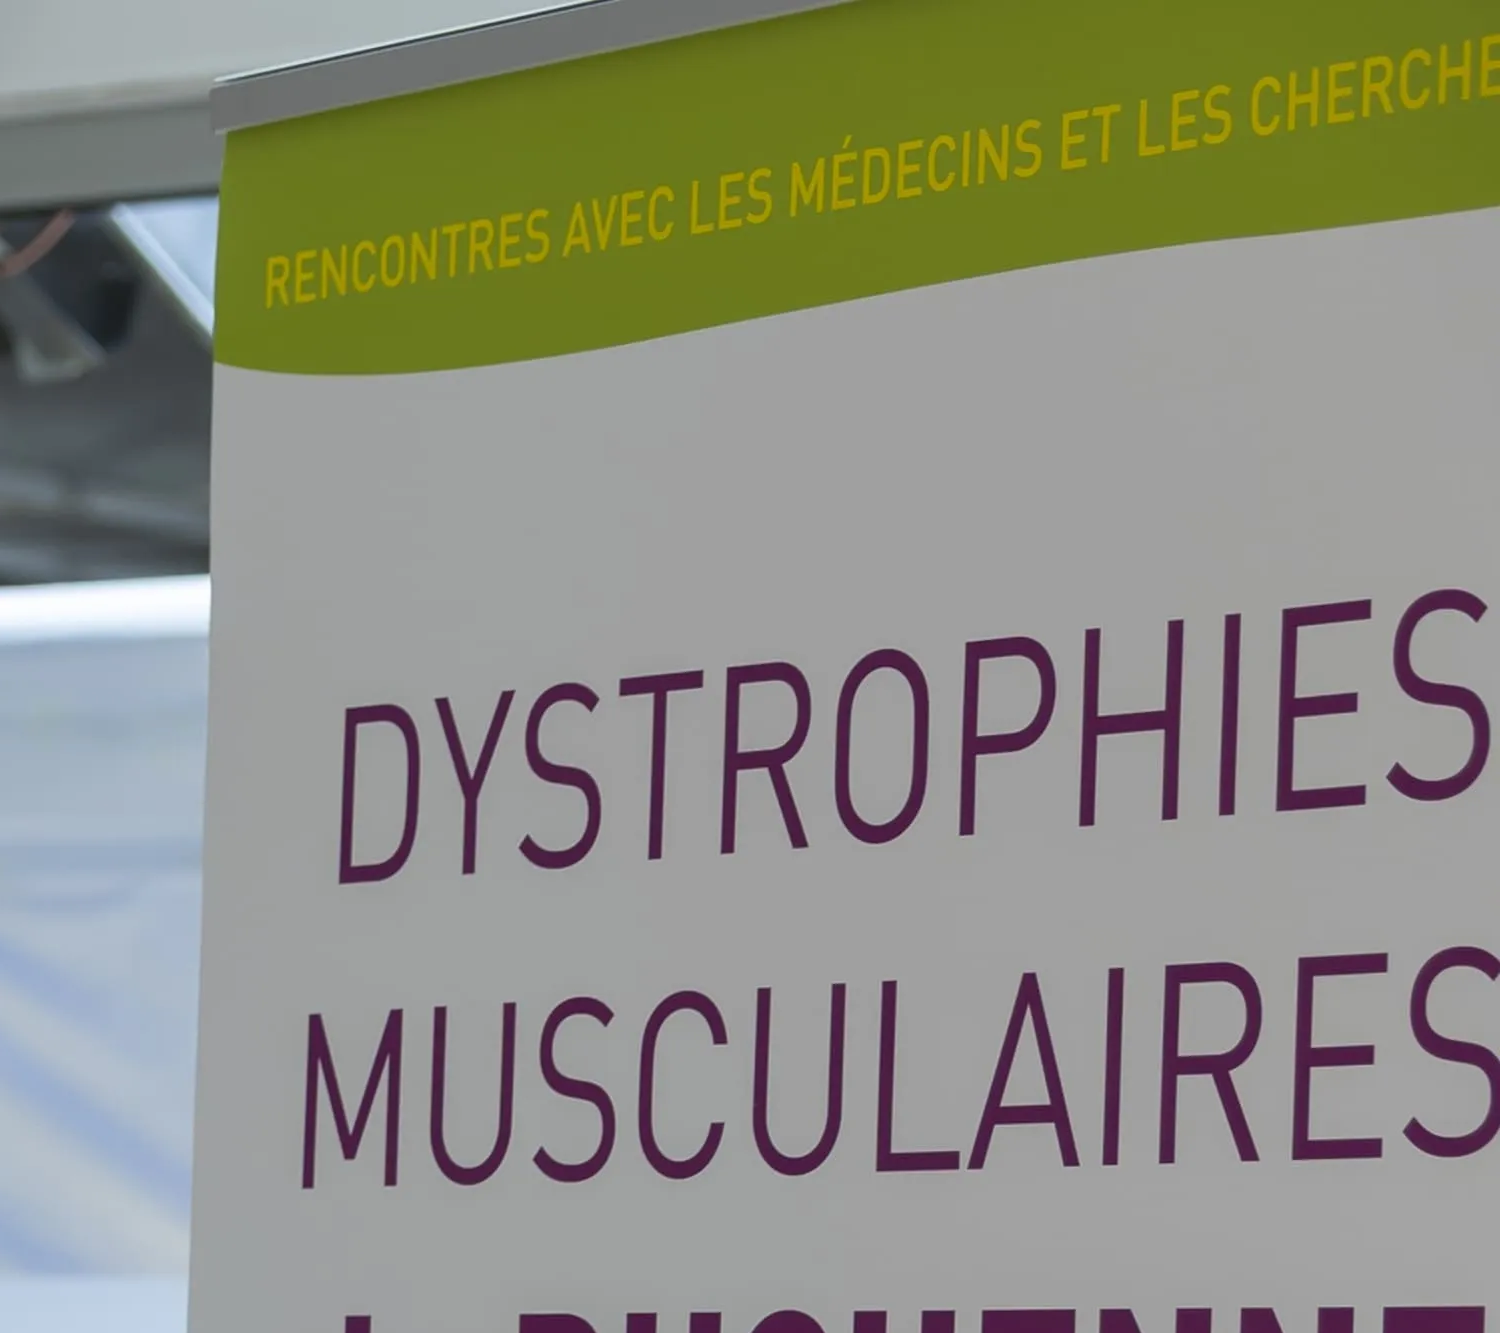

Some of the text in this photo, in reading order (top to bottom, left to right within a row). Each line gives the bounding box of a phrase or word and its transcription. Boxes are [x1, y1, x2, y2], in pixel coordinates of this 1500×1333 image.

[264, 33, 1500, 308] RENCONTRES AVEC LES MÉDECINS ET LES CHERCHE
[338, 588, 1492, 884] DYSTROPHIES
[301, 946, 1500, 1190] MUSCULAIRES
